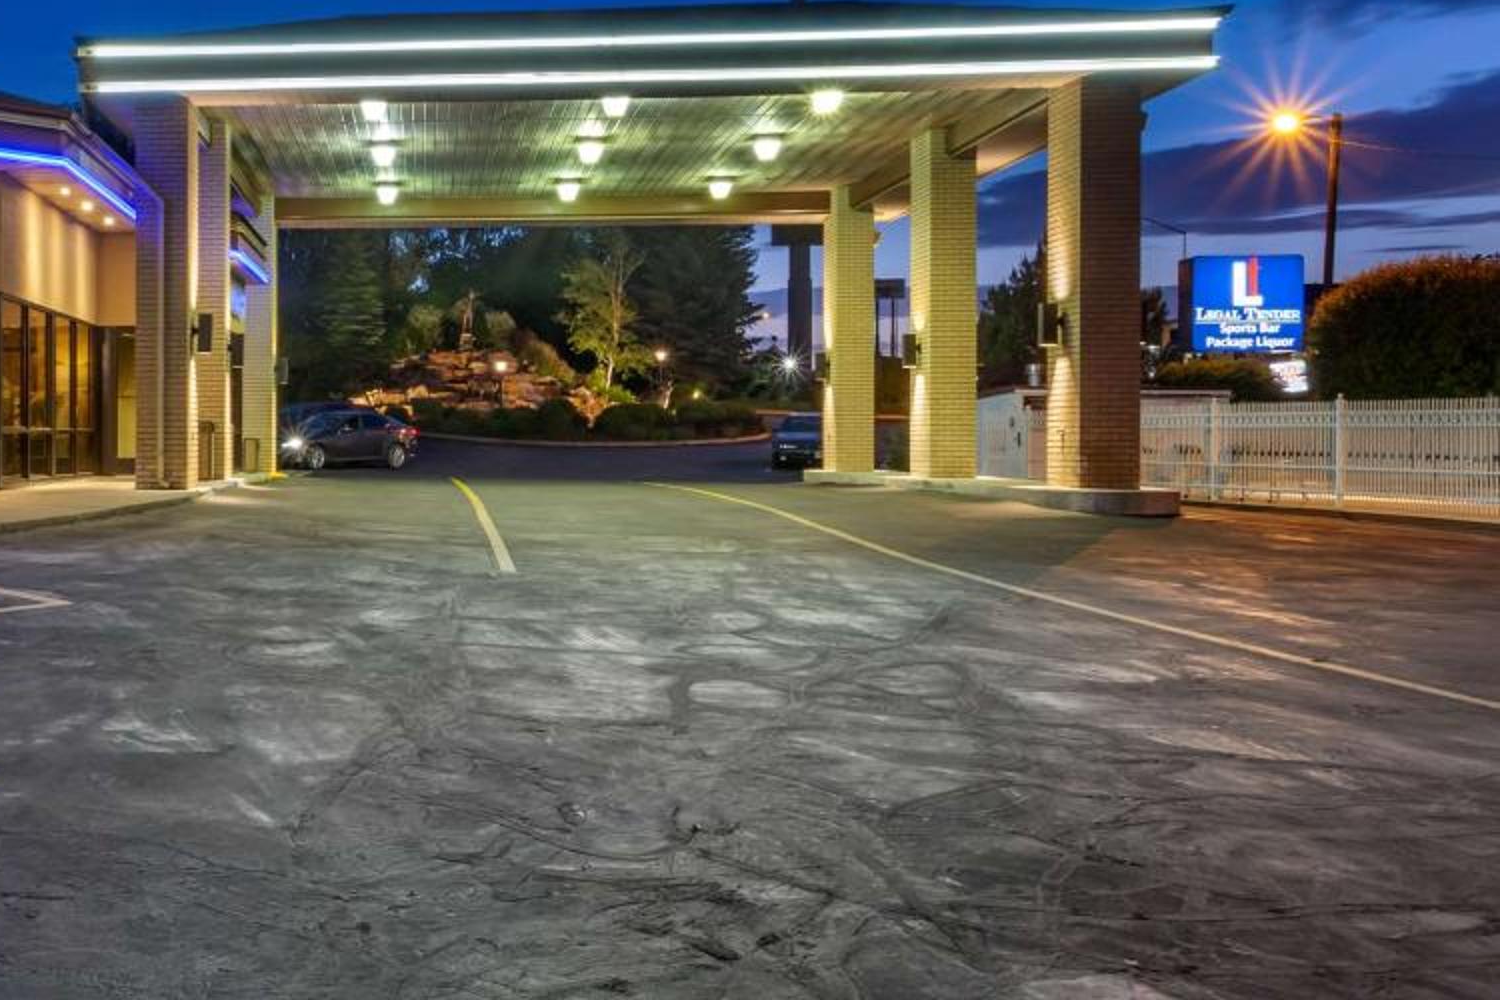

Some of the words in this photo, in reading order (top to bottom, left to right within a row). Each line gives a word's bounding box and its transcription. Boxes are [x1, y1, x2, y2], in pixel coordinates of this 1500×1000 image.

[1220, 321, 1257, 334] Sports
[1259, 321, 1280, 333] Bar
[1206, 336, 1253, 349] Package
[1256, 336, 1295, 348] Liquor
